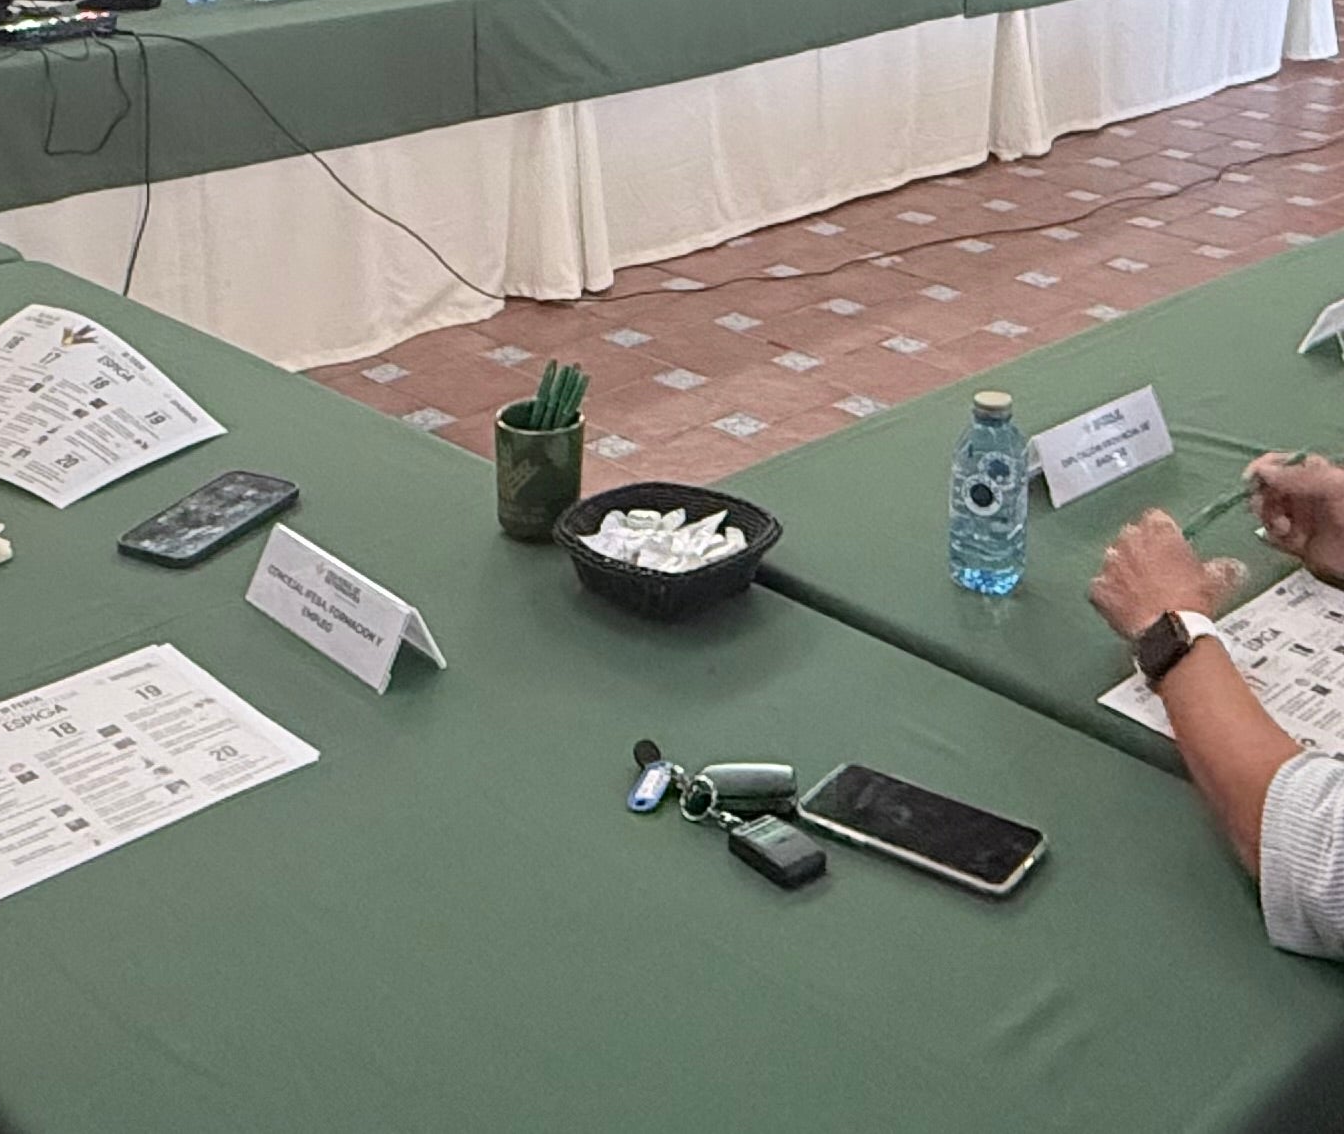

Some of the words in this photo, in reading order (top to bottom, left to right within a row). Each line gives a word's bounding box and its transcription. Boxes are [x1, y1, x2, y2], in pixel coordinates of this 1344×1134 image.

[135, 684, 163, 701] 19
[1, 703, 68, 732] ESPIGA
[48, 722, 78, 739] 18
[209, 744, 239, 762] 20
